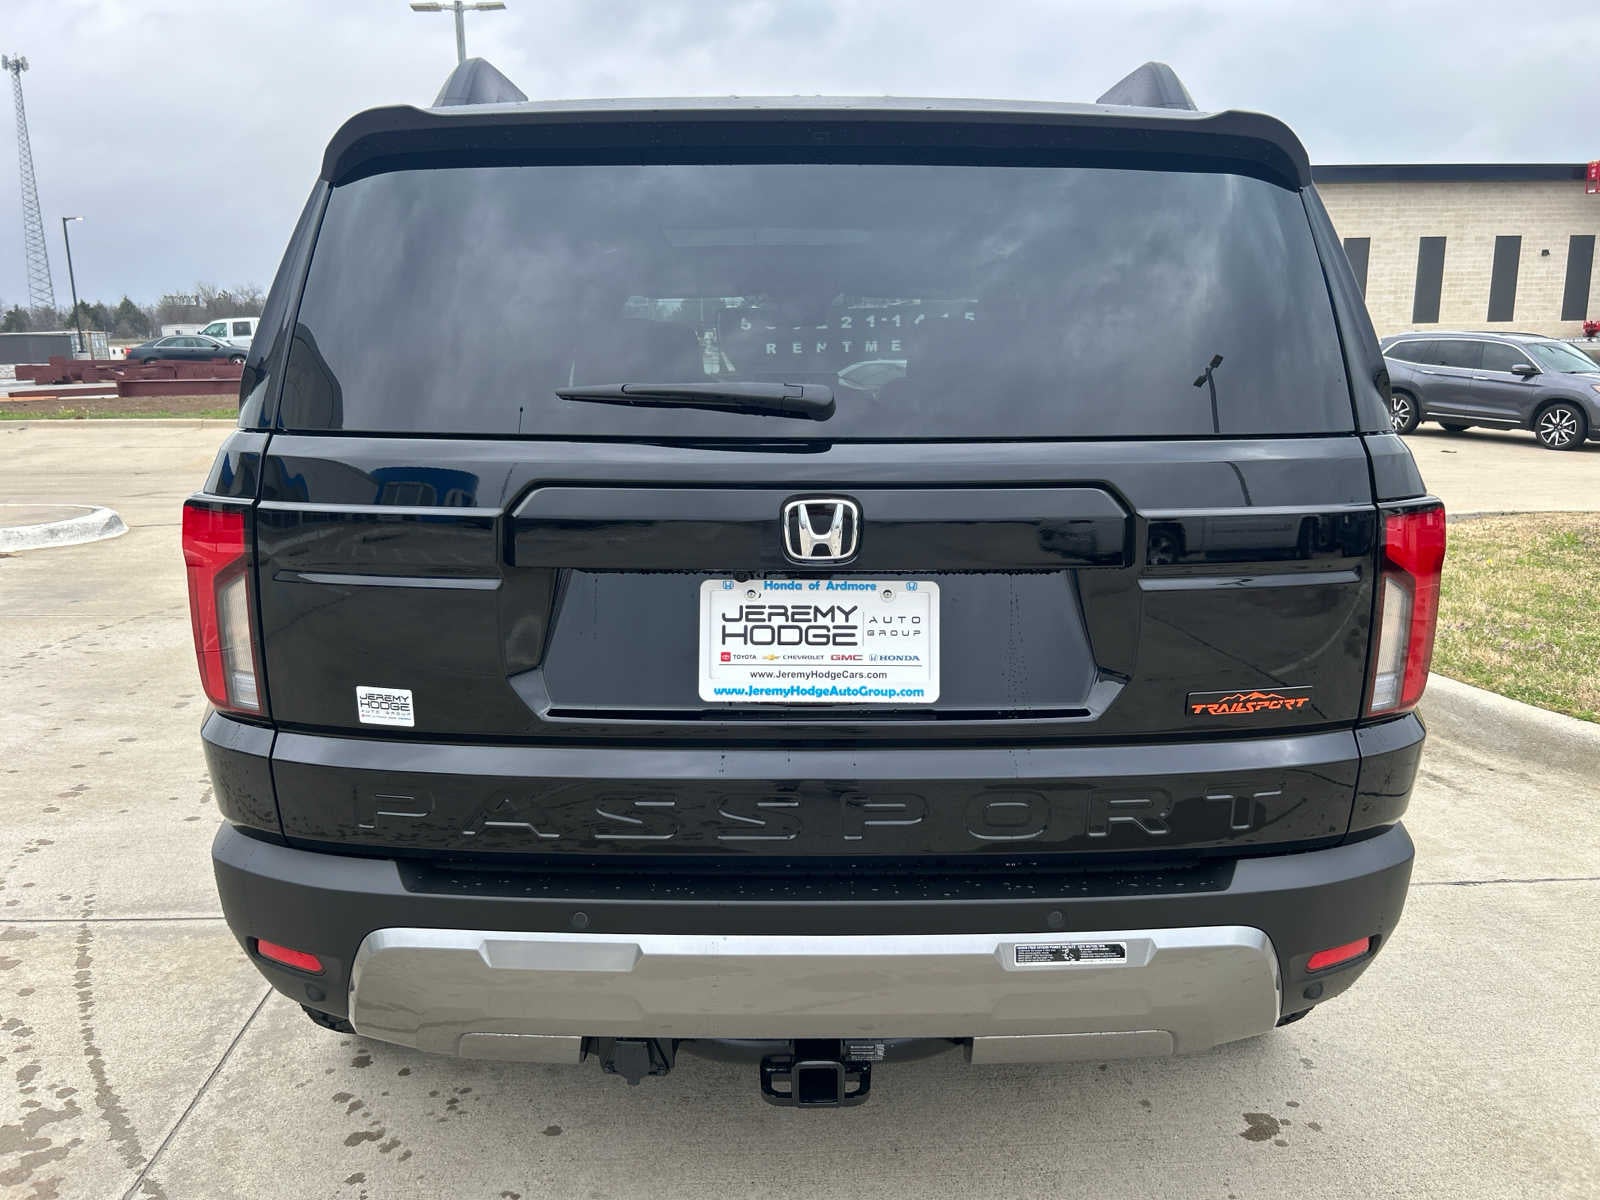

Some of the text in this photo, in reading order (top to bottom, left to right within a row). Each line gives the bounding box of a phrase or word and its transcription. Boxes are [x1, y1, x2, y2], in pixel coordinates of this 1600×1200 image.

[763, 580, 877, 592] Honda of Ardmore
[721, 605, 858, 623] JEREMY
[868, 616, 921, 624] AUTO
[721, 624, 858, 646] HODGE
[867, 629, 921, 637] GROUP
[750, 670, 888, 681] www.JeremyHodgeCars.com
[360, 693, 409, 702] JEREMY
[713, 685, 925, 698] www.JeremyHodgeAutoGroup.com
[360, 700, 410, 711] HODGE
[1191, 697, 1310, 715] TRAILSPORT
[354, 783, 1286, 842] PASSPORT
